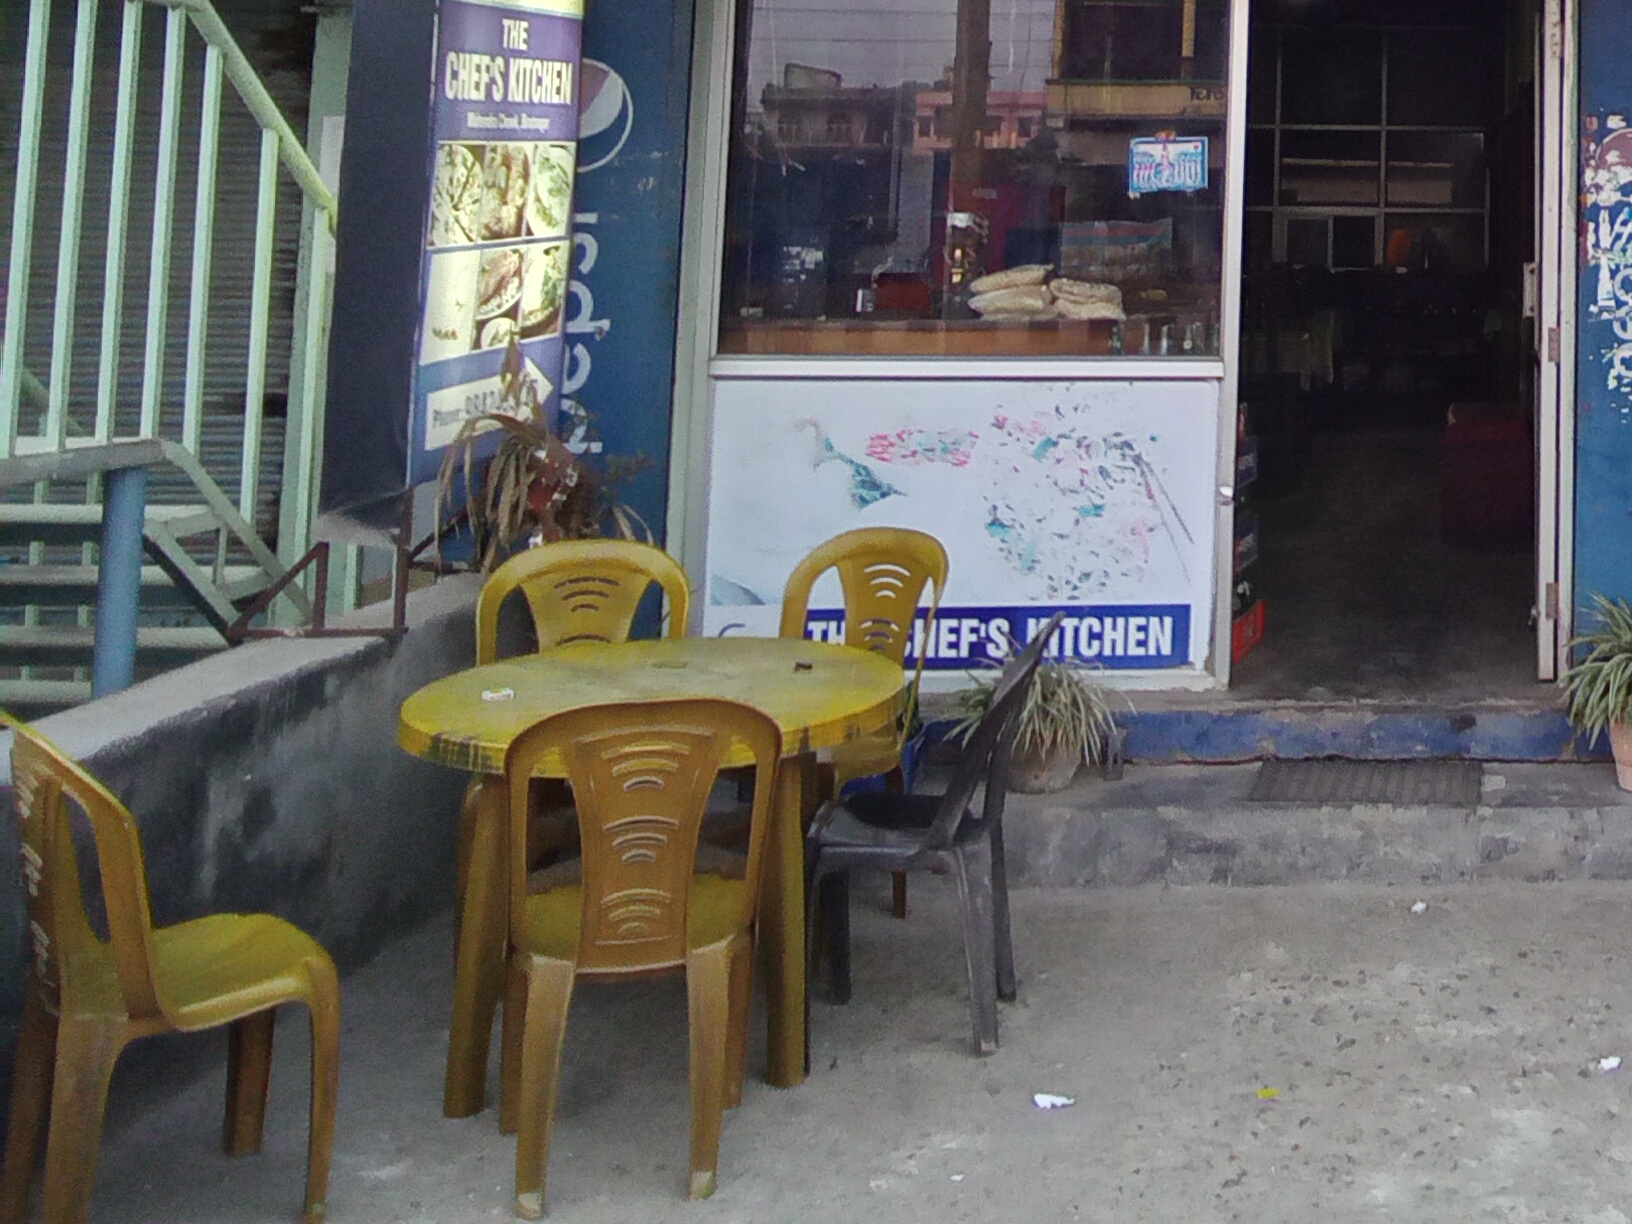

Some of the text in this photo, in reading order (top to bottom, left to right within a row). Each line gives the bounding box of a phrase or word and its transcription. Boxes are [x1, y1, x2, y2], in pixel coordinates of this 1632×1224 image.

[502, 18, 529, 52] THE
[444, 51, 573, 106] CHEF'S KITCHEN
